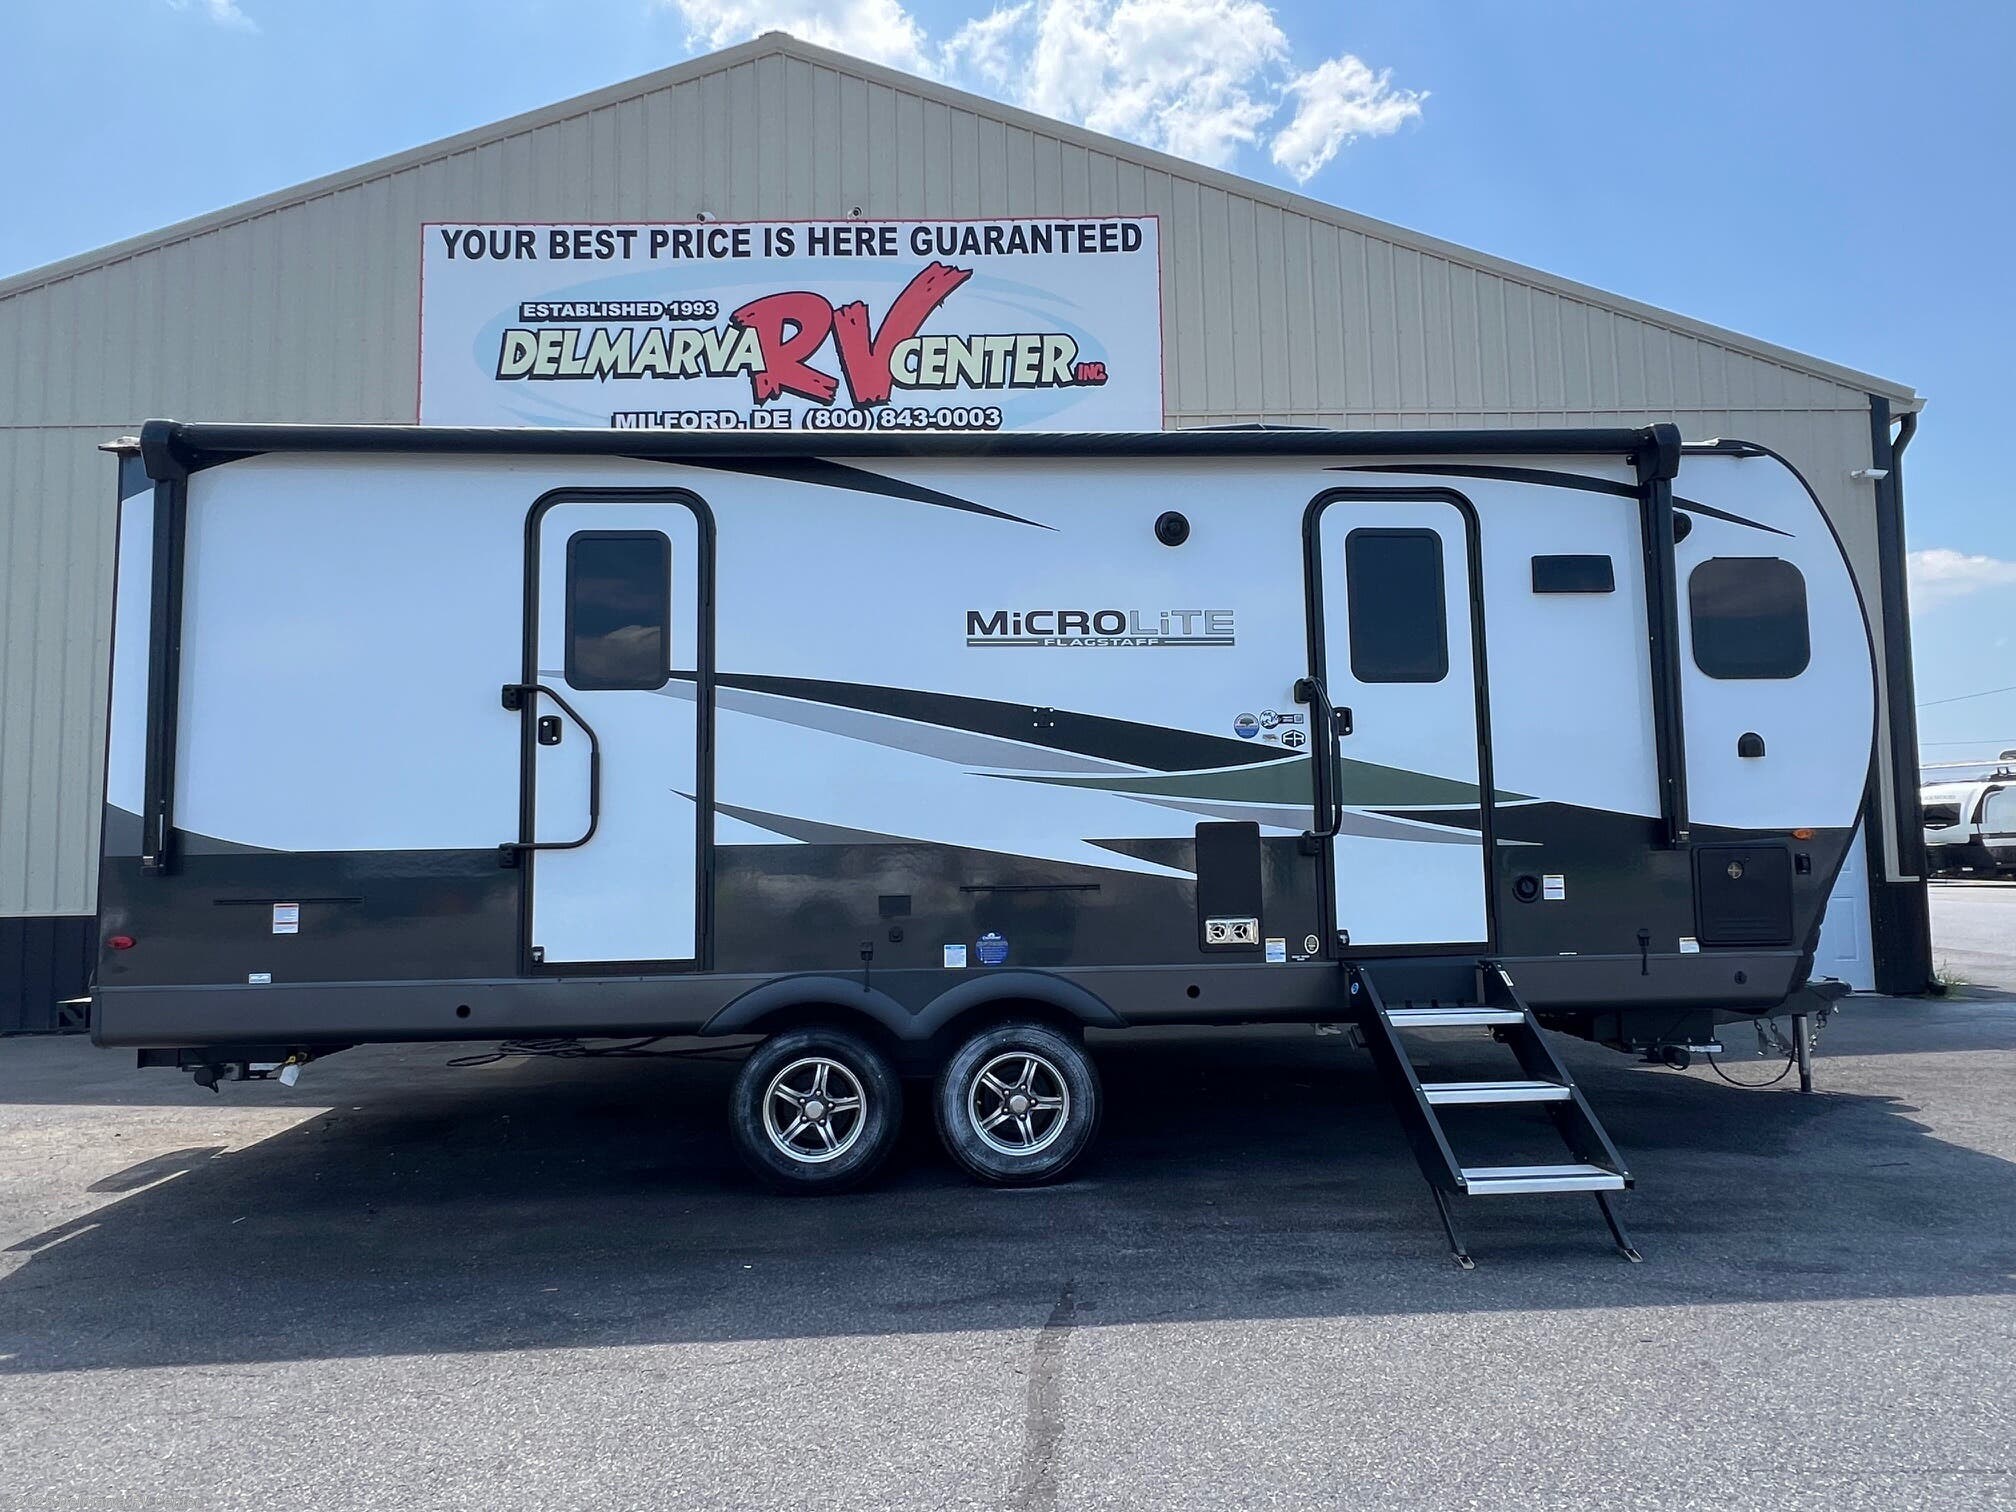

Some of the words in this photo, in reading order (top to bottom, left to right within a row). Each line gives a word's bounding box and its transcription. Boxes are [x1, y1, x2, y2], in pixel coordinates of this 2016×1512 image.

[441, 229, 537, 260] YOUR
[549, 229, 638, 260] BEST
[650, 228, 751, 259] PRICE
[764, 227, 796, 258] IS
[808, 226, 898, 257] HERE
[910, 223, 1142, 257] GUARANTEED
[522, 301, 664, 319] ESTABLISHED
[668, 300, 718, 317] 1993
[498, 326, 767, 378] DELMARVA
[729, 261, 973, 406] RV
[889, 333, 1079, 386] CENTER
[753, 410, 791, 429] DE
[805, 409, 873, 430] (800)
[880, 408, 1001, 429] 843-0003
[1044, 638, 1159, 647] FLAGSTAFF
